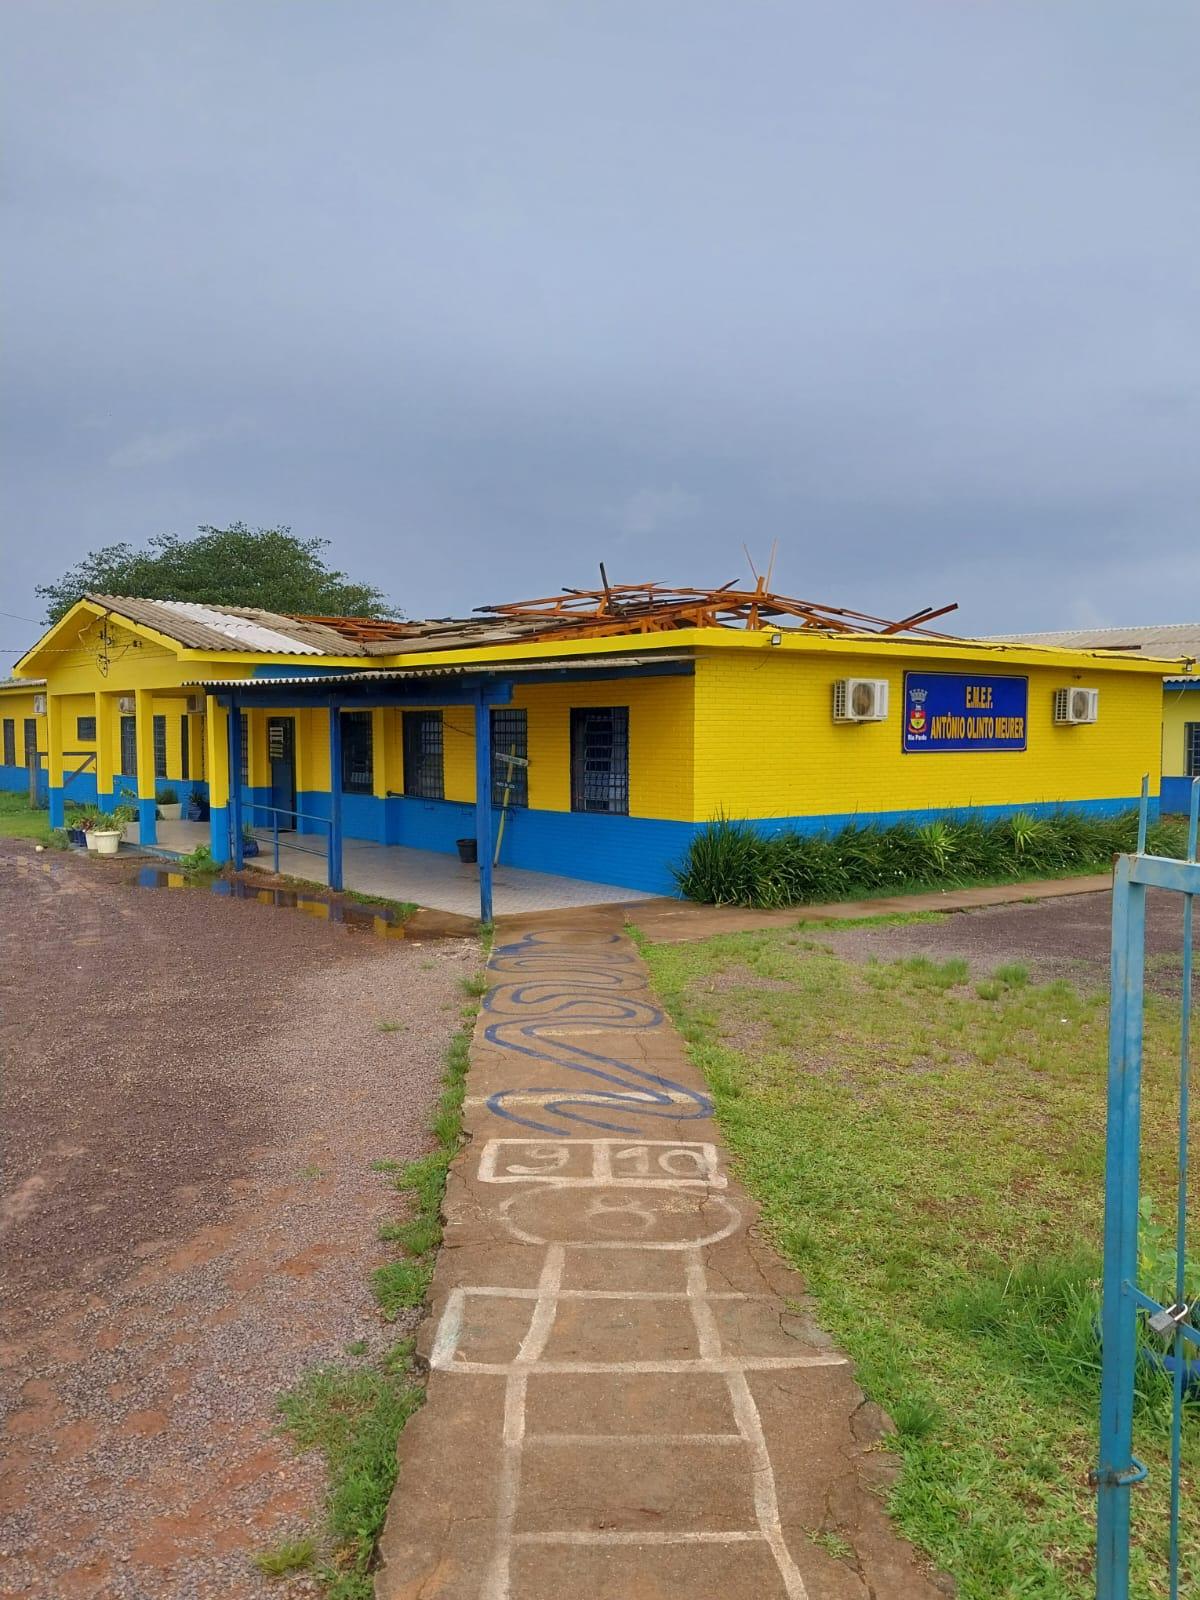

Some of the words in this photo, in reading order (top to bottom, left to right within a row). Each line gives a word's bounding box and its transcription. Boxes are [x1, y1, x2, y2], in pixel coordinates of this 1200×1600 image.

[967, 716, 994, 738] OLINTO
[995, 717, 1024, 738] MEURER
[616, 1146, 712, 1177] 10
